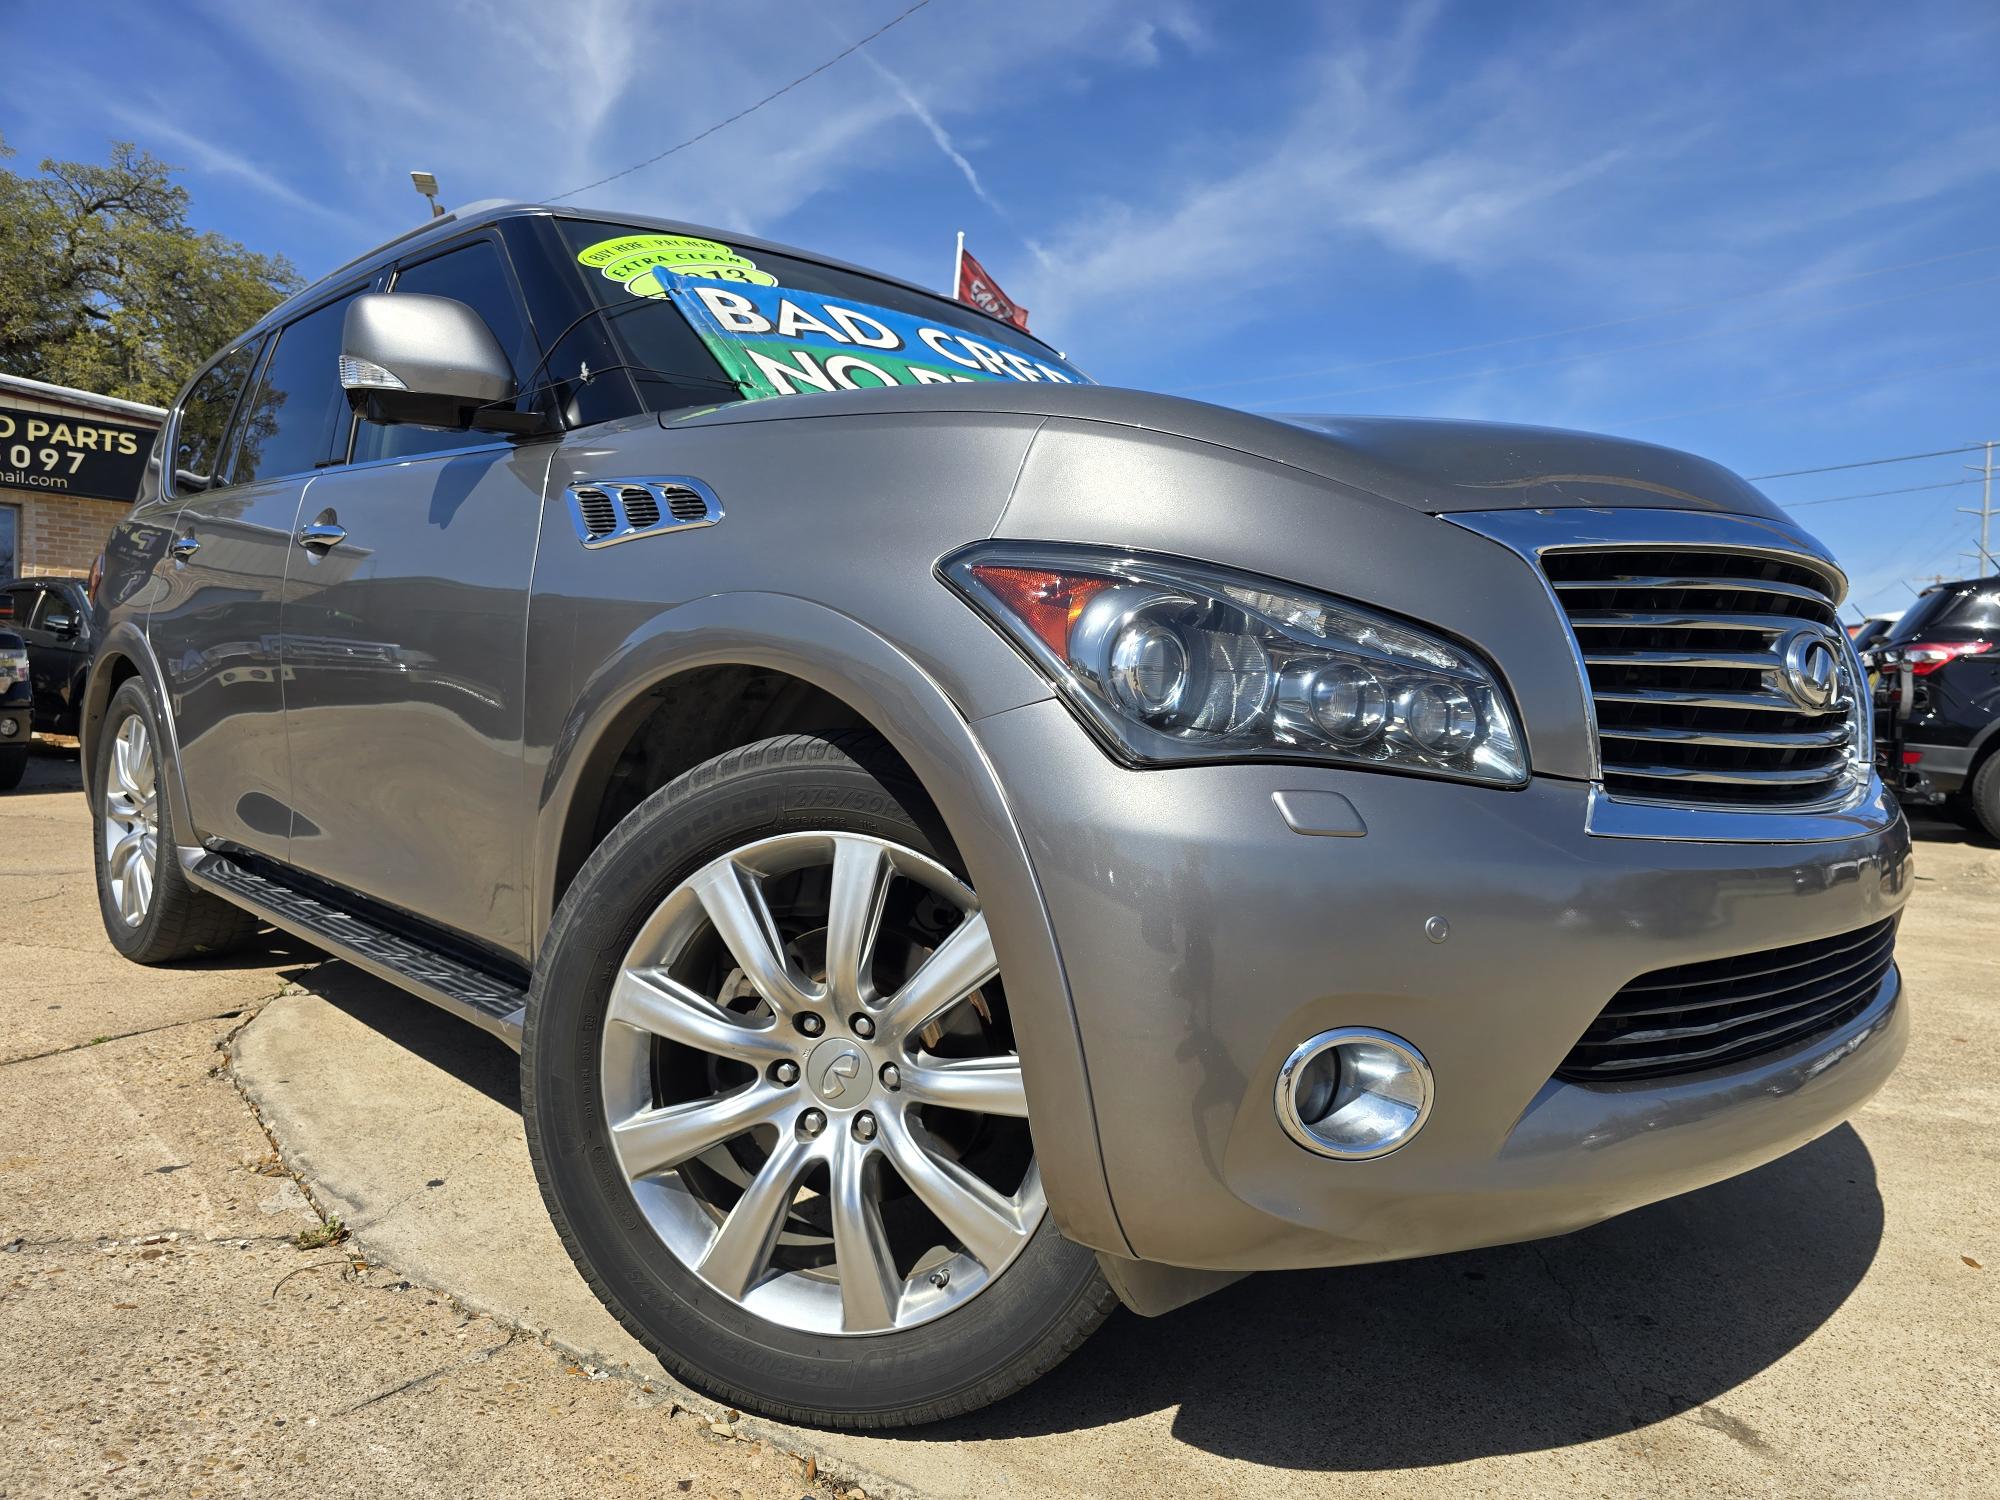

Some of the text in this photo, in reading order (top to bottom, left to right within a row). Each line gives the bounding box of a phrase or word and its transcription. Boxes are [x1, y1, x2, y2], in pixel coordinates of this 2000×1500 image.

[589, 239, 717, 263] BUY HERE PAY HERE
[612, 253, 741, 278] EXTRA CLEAN
[694, 287, 902, 350] BAD
[745, 349, 899, 395] NO
[27, 419, 138, 455] PARTS
[0, 444, 86, 474] 097
